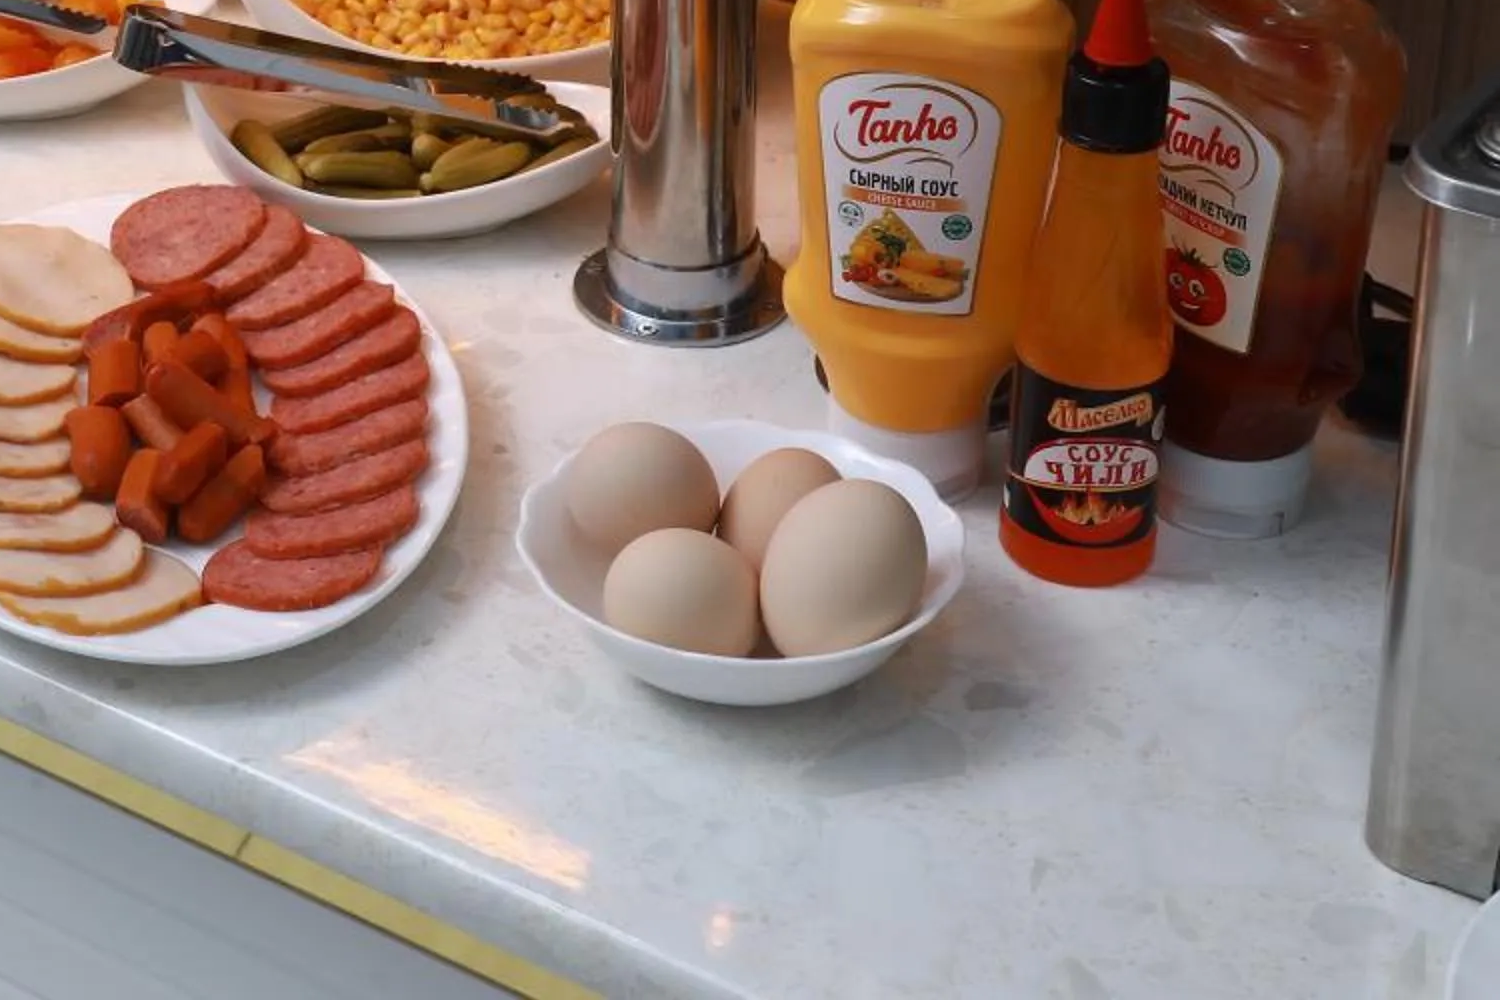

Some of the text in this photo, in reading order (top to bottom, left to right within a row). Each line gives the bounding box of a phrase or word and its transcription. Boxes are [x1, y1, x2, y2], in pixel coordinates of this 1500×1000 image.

[848, 99, 958, 147] Tanho
[1166, 106, 1241, 171] Tanho
[849, 168, 959, 197] СЫРНЫЙ СОУС
[1200, 197, 1248, 231] КЕТЧУП
[1067, 445, 1133, 463] СОУС
[1044, 459, 1148, 485] ЧИЛИ
